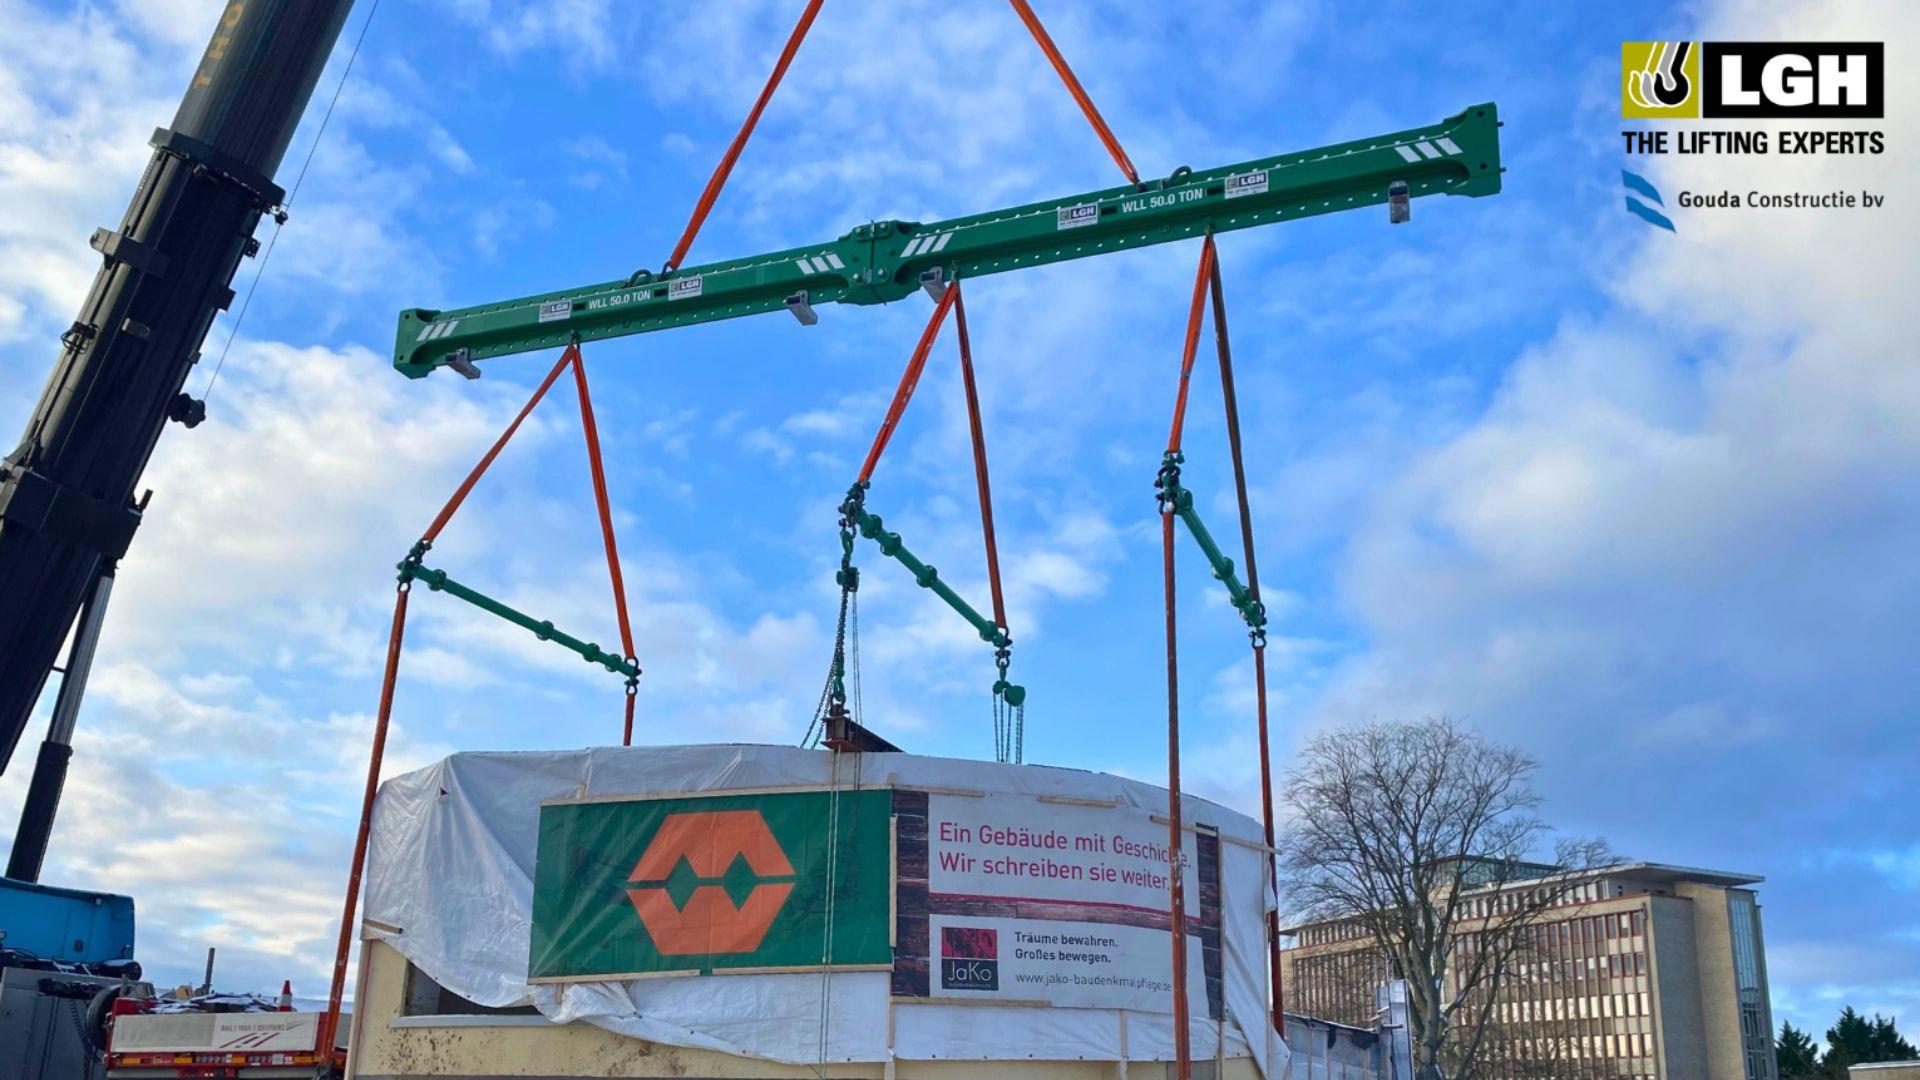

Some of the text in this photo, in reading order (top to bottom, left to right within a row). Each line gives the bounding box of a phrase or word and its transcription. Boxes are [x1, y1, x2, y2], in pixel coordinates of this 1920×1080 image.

[1241, 173, 1265, 186] LGH
[1122, 188, 1203, 213] WLL 50.0 TON
[1072, 206, 1095, 218] LGH
[588, 290, 651, 310] WLL 50.0 TON
[940, 822, 1191, 869] Ein Gebäude mit Geschice.
[939, 851, 1170, 891] Wir schreiben sie weiter.
[1015, 931, 1119, 948] Träume bewahren.
[1015, 949, 1112, 965] Großes bewegen.
[948, 961, 992, 981] JaKo
